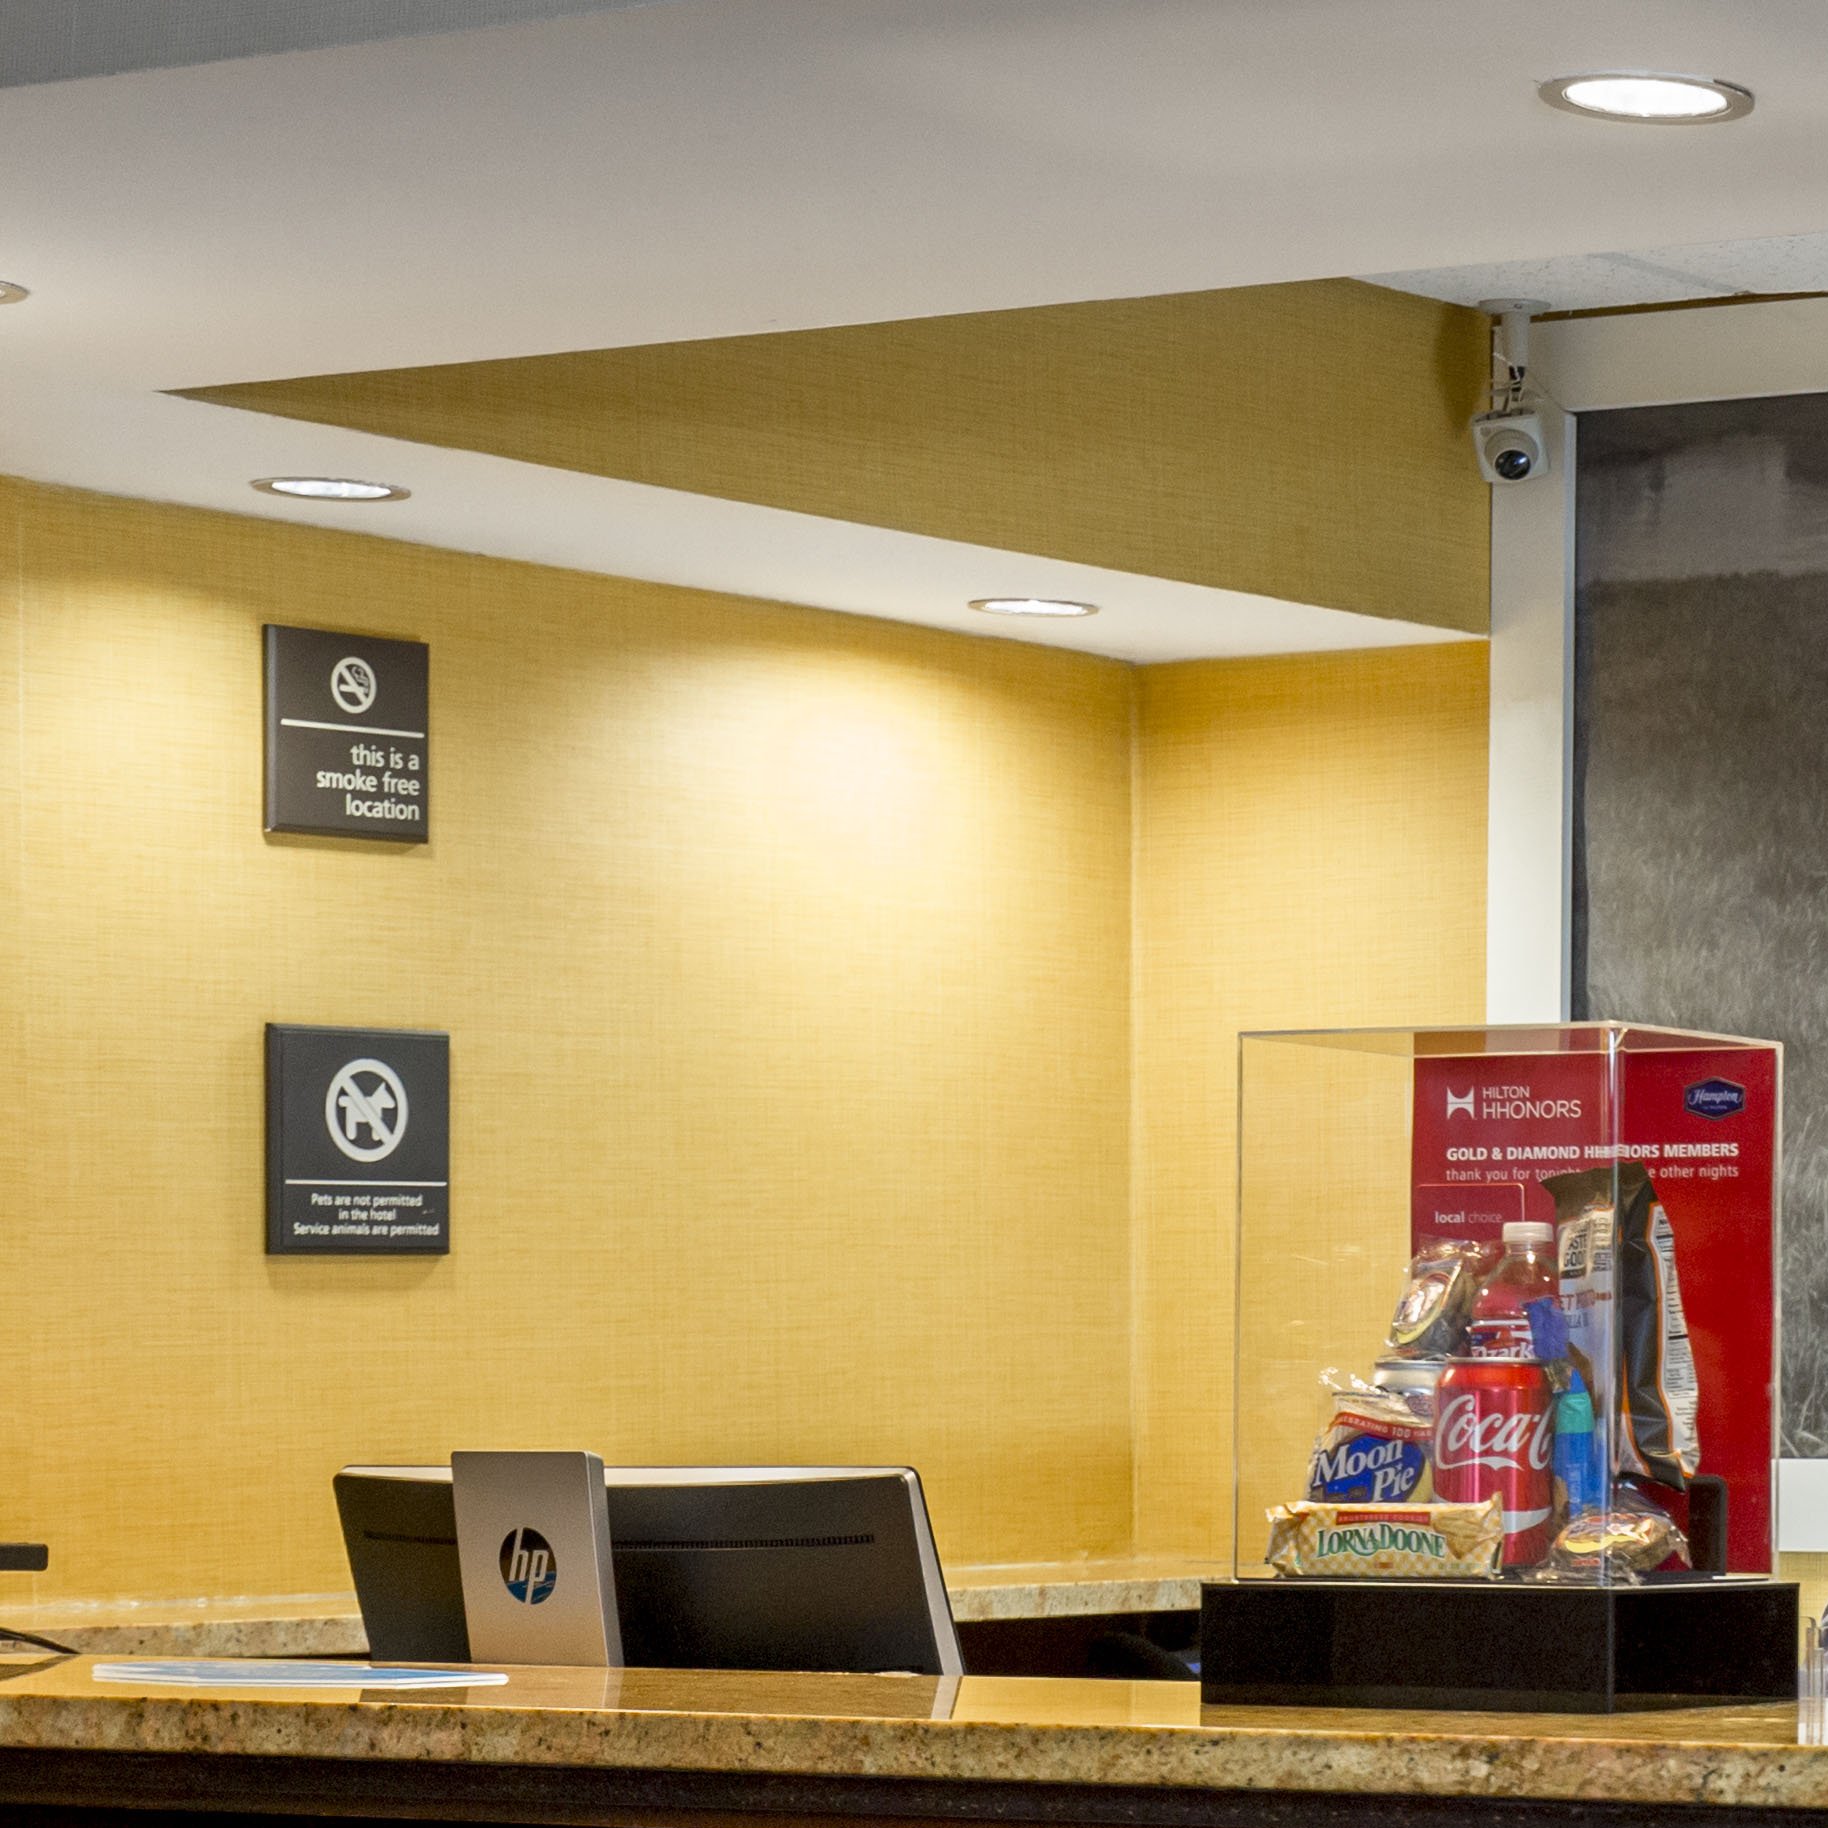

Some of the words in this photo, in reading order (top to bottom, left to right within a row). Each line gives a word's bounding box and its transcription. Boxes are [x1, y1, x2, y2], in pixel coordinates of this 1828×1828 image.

[350, 743, 385, 768] this
[390, 747, 404, 769] is
[408, 753, 420, 770] a
[316, 768, 378, 792] smoke
[382, 771, 420, 796] free
[345, 792, 420, 820] location
[1482, 1086, 1530, 1099] HILTON
[1482, 1100, 1582, 1119] HHONORS
[1446, 1147, 1488, 1161] GOLD
[1491, 1147, 1503, 1160] &
[1506, 1146, 1580, 1160] DIAMOND
[1584, 1144, 1660, 1159] HHORS
[1663, 1143, 1739, 1157] MEMBERS
[1446, 1168, 1482, 1181] thank
[1485, 1171, 1508, 1184] you
[1512, 1167, 1530, 1181] for
[1660, 1165, 1694, 1178] other
[1698, 1164, 1739, 1180] nights
[311, 1193, 333, 1206] Pets
[334, 1195, 351, 1206] are
[353, 1195, 371, 1206] not
[373, 1193, 423, 1208] permitted
[338, 1208, 349, 1220] in
[351, 1208, 368, 1220] the
[370, 1208, 397, 1221] hotel
[1435, 1210, 1465, 1224] local
[293, 1222, 331, 1235] Service
[331, 1223, 370, 1236] animals
[372, 1225, 389, 1235] are
[390, 1223, 440, 1237] permitted
[1312, 1439, 1403, 1487] Moon
[1373, 1464, 1415, 1501] Pie
[508, 1528, 550, 1605] hp
